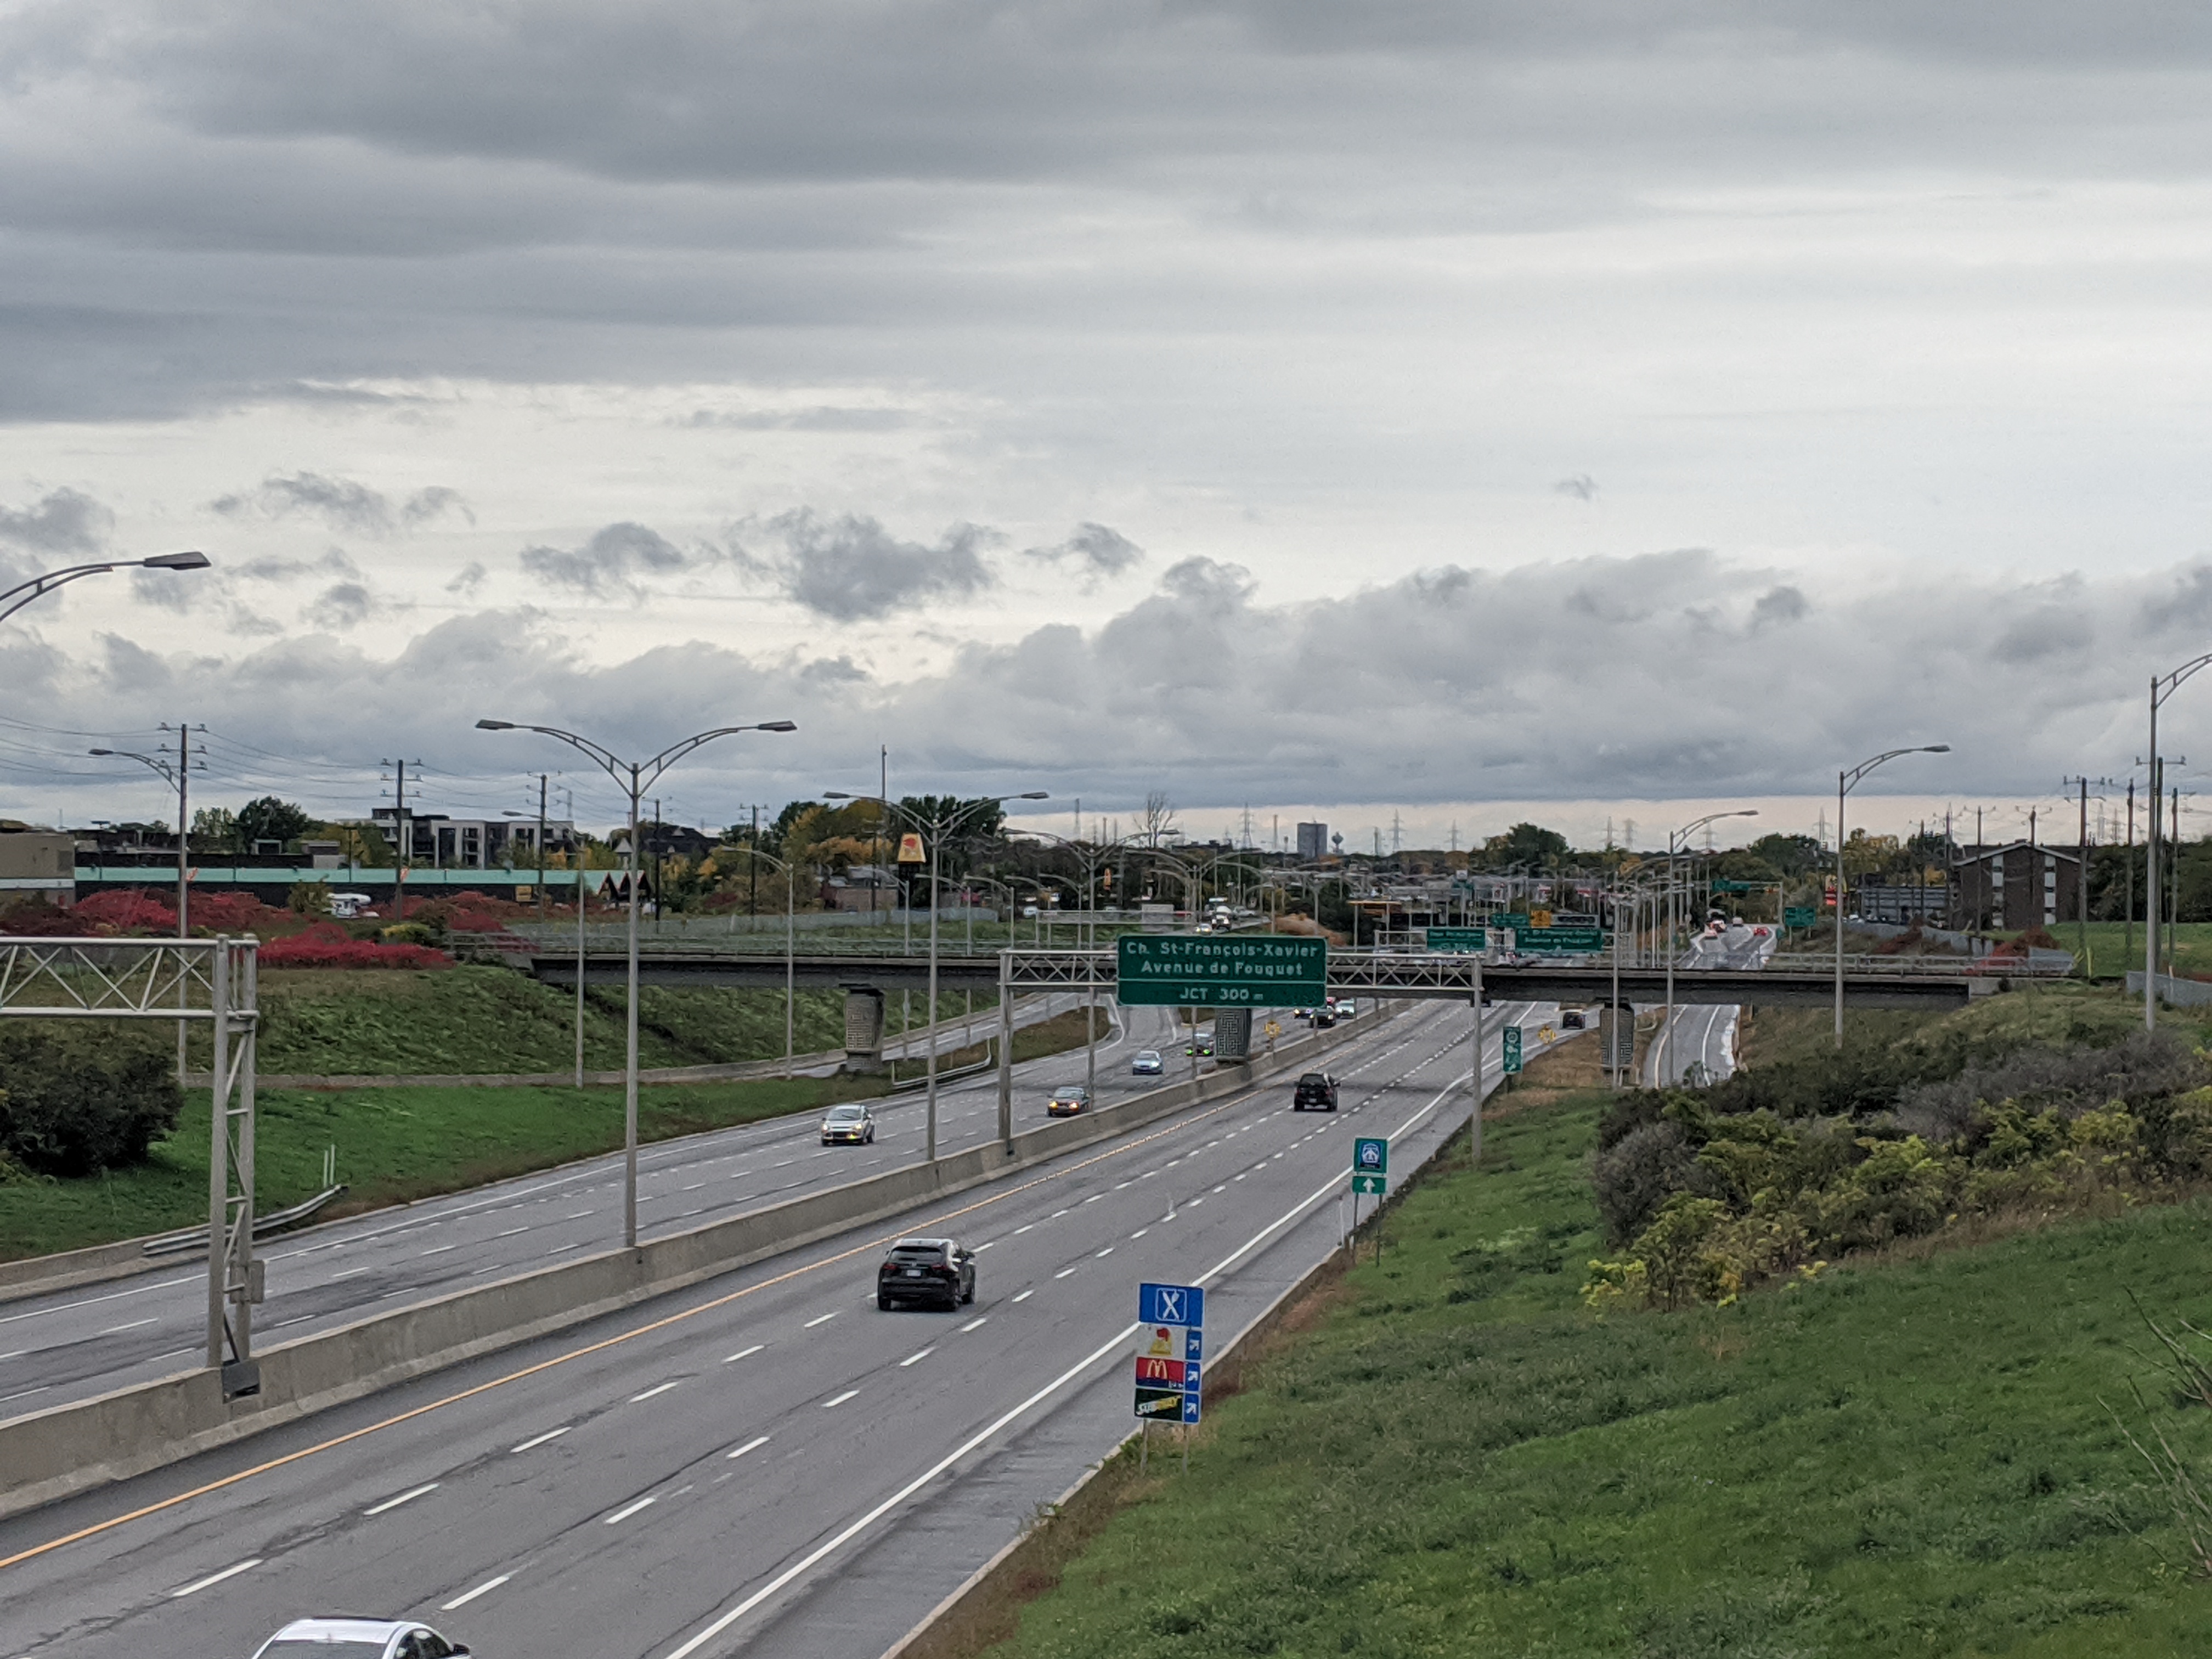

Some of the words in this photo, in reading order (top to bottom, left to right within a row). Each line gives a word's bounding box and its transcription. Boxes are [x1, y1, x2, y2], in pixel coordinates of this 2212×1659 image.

[1160, 941, 1317, 957] St-François-Xavier
[1141, 960, 1204, 974] Avenue
[1210, 962, 1229, 974] de
[1235, 962, 1302, 977] Fouquet
[1180, 988, 1208, 1000] JCT
[1220, 988, 1249, 1000] 300
